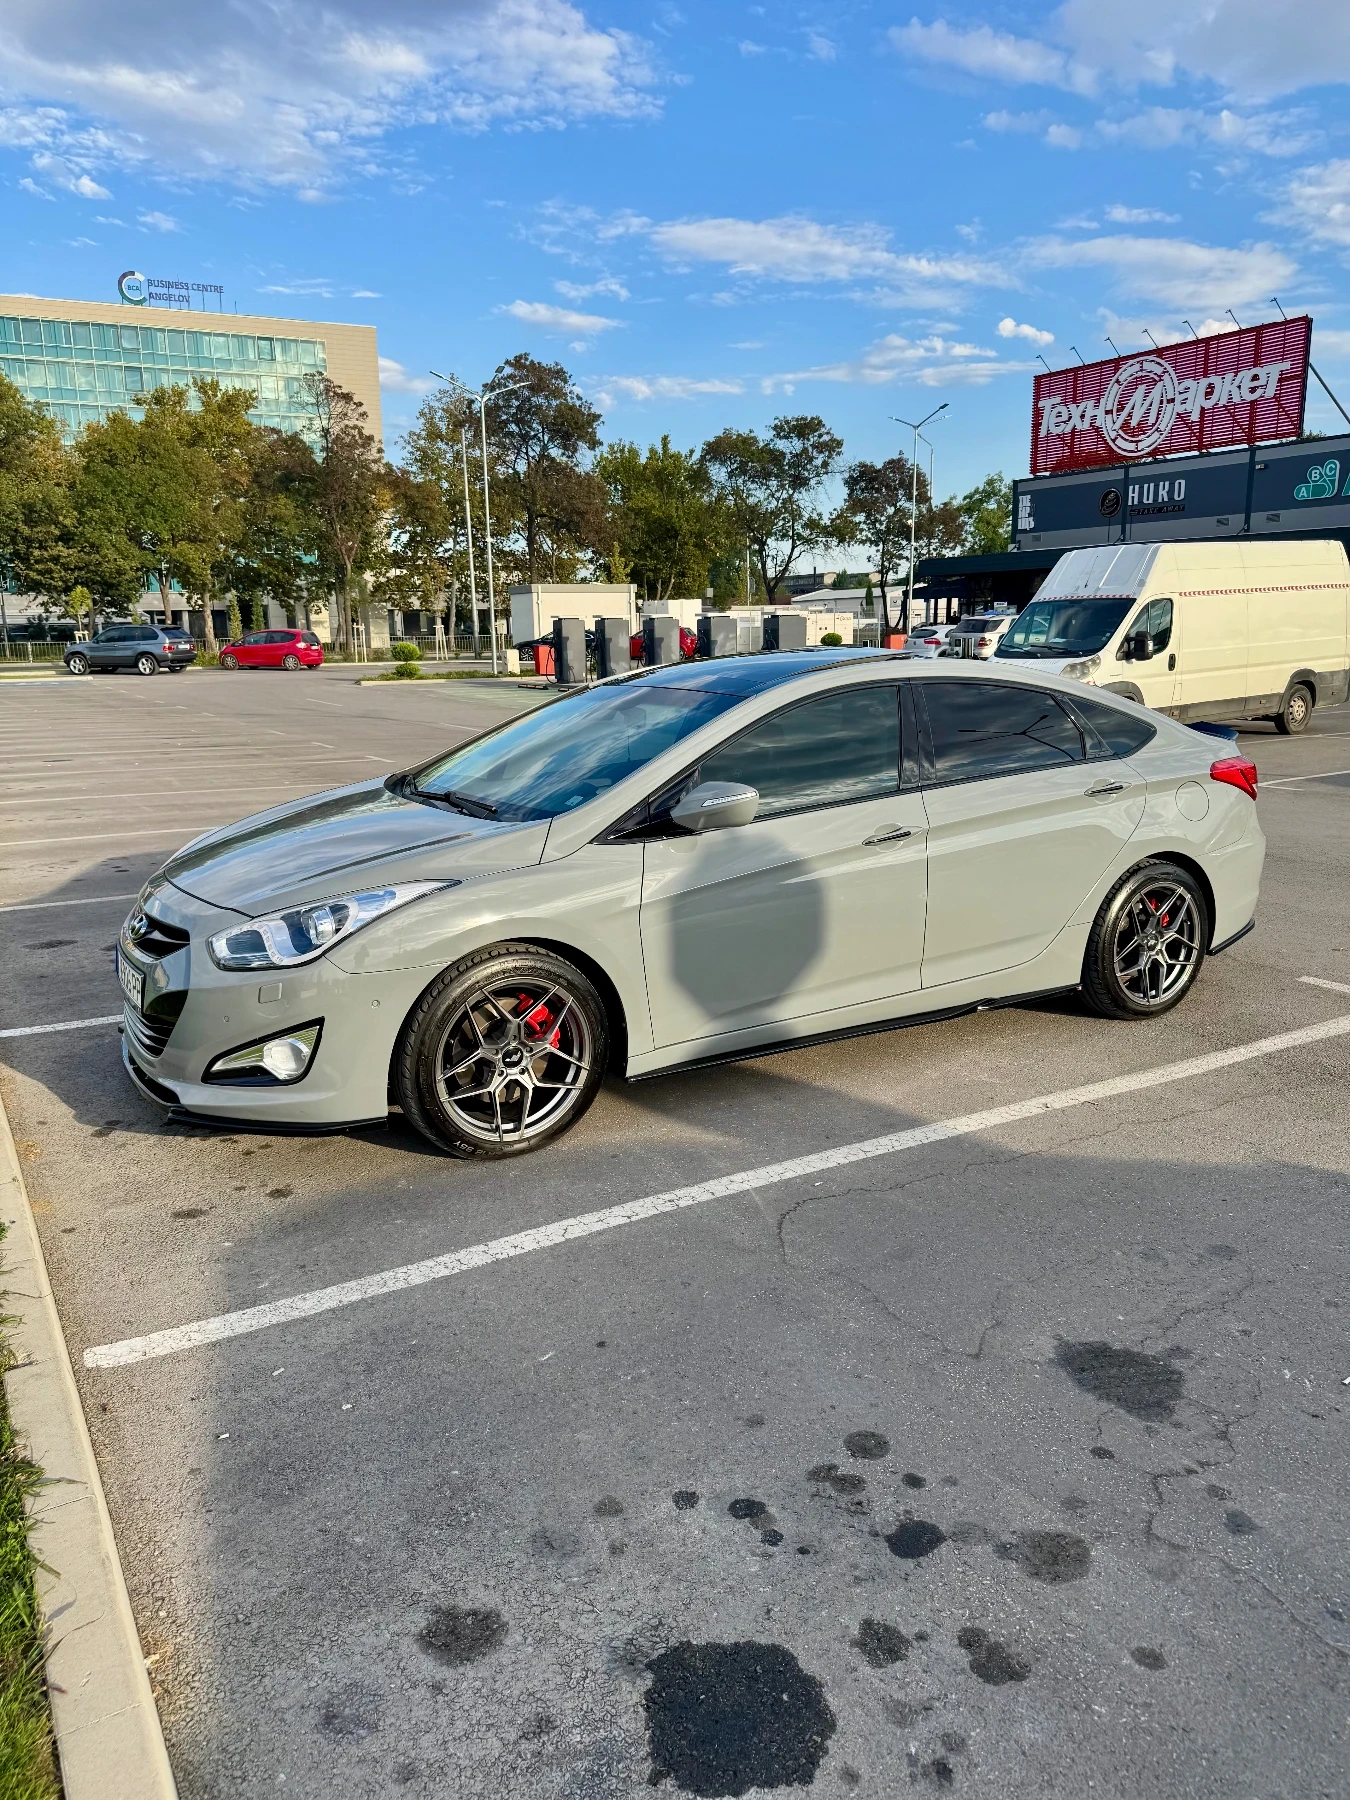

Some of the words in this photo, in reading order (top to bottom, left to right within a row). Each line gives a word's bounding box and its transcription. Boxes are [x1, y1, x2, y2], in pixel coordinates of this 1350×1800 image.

[147, 279, 189, 290] BUSINESS
[191, 283, 224, 293] CENTRE
[149, 292, 190, 303] ANGELOV
[1127, 479, 1186, 506] HUKO
[1161, 504, 1185, 513] AWAY
